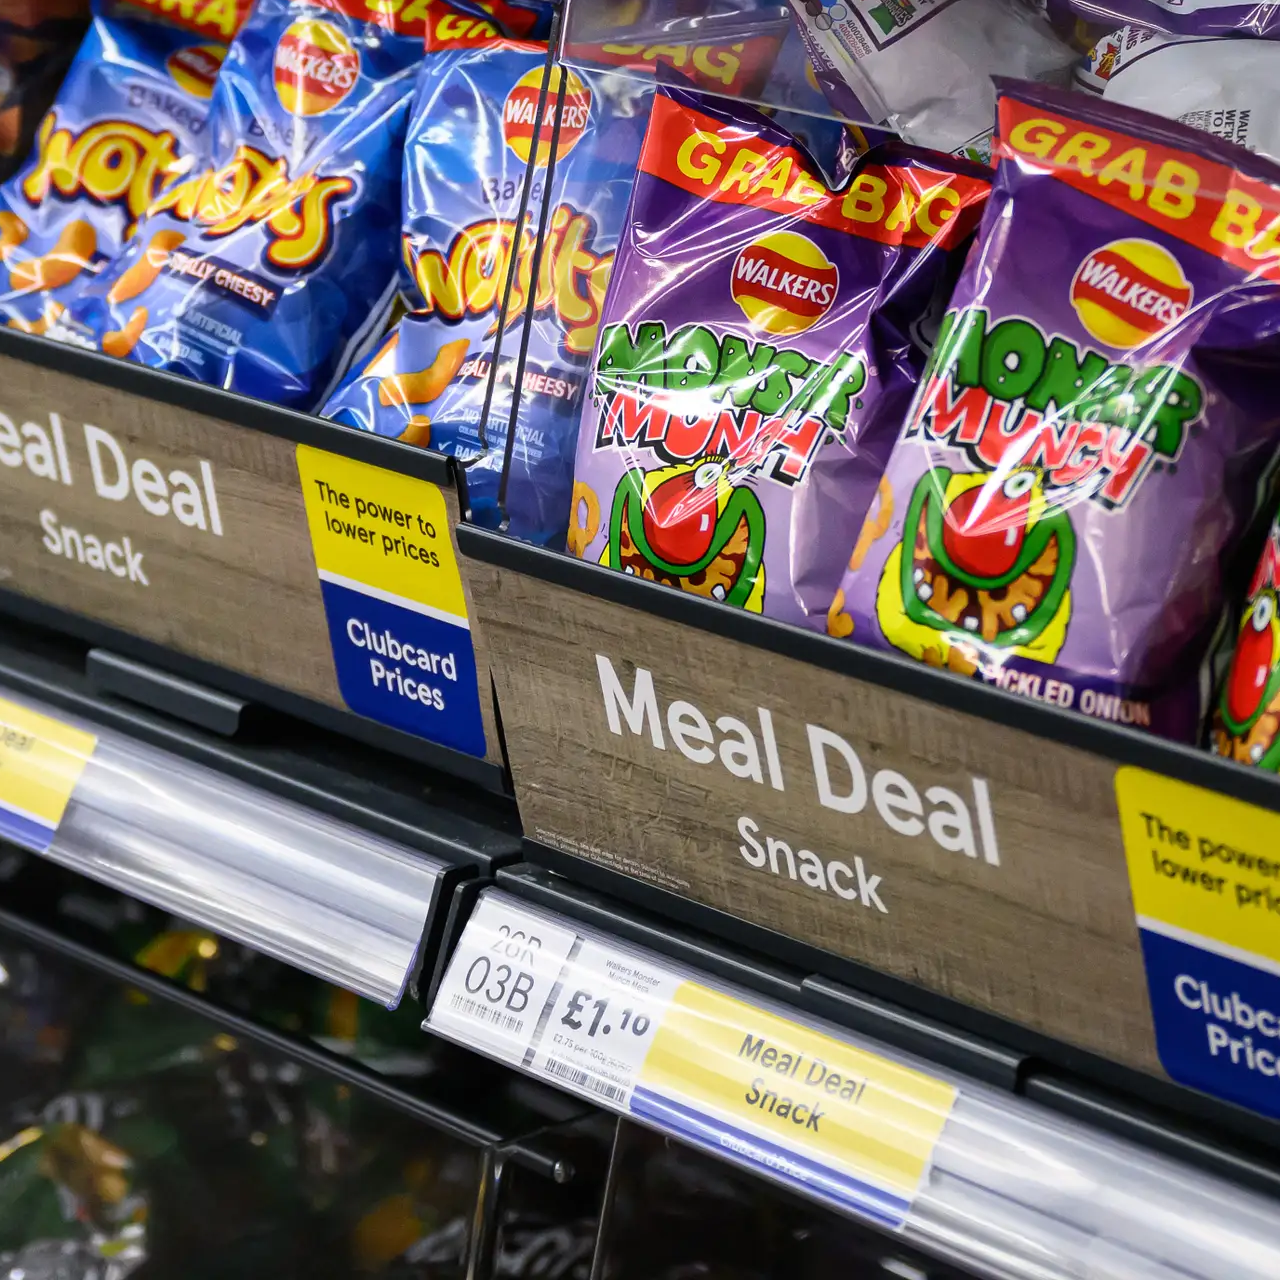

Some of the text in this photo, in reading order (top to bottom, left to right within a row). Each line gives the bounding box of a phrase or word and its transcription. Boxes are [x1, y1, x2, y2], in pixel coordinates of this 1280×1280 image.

[677, 130, 961, 237] GRAB BAG
[1008, 116, 1198, 222] GRAB
[215, 269, 276, 307] CHEESY
[736, 254, 839, 308] WALKERS
[1080, 257, 1187, 326] WALKERS
[85, 423, 225, 536] Deal
[314, 479, 438, 540] The power to
[39, 510, 150, 587] Snack
[324, 511, 441, 568] lower prices
[345, 619, 457, 682] Clubcard
[369, 658, 446, 711] Prices
[1080, 689, 1151, 728] ONION
[594, 653, 786, 793] Meal
[807, 723, 1000, 868] Deal
[736, 816, 889, 915] Snack
[1140, 810, 1190, 850] The
[1198, 831, 1279, 880] power
[1152, 851, 1227, 897] lower
[464, 954, 535, 1013] 03B
[605, 959, 661, 987] Walkers Monster
[553, 1033, 575, 1049] £2.75
[560, 989, 651, 1038] £1.10
[738, 1033, 869, 1107] Meal Deal
[744, 1077, 827, 1133] Snack
